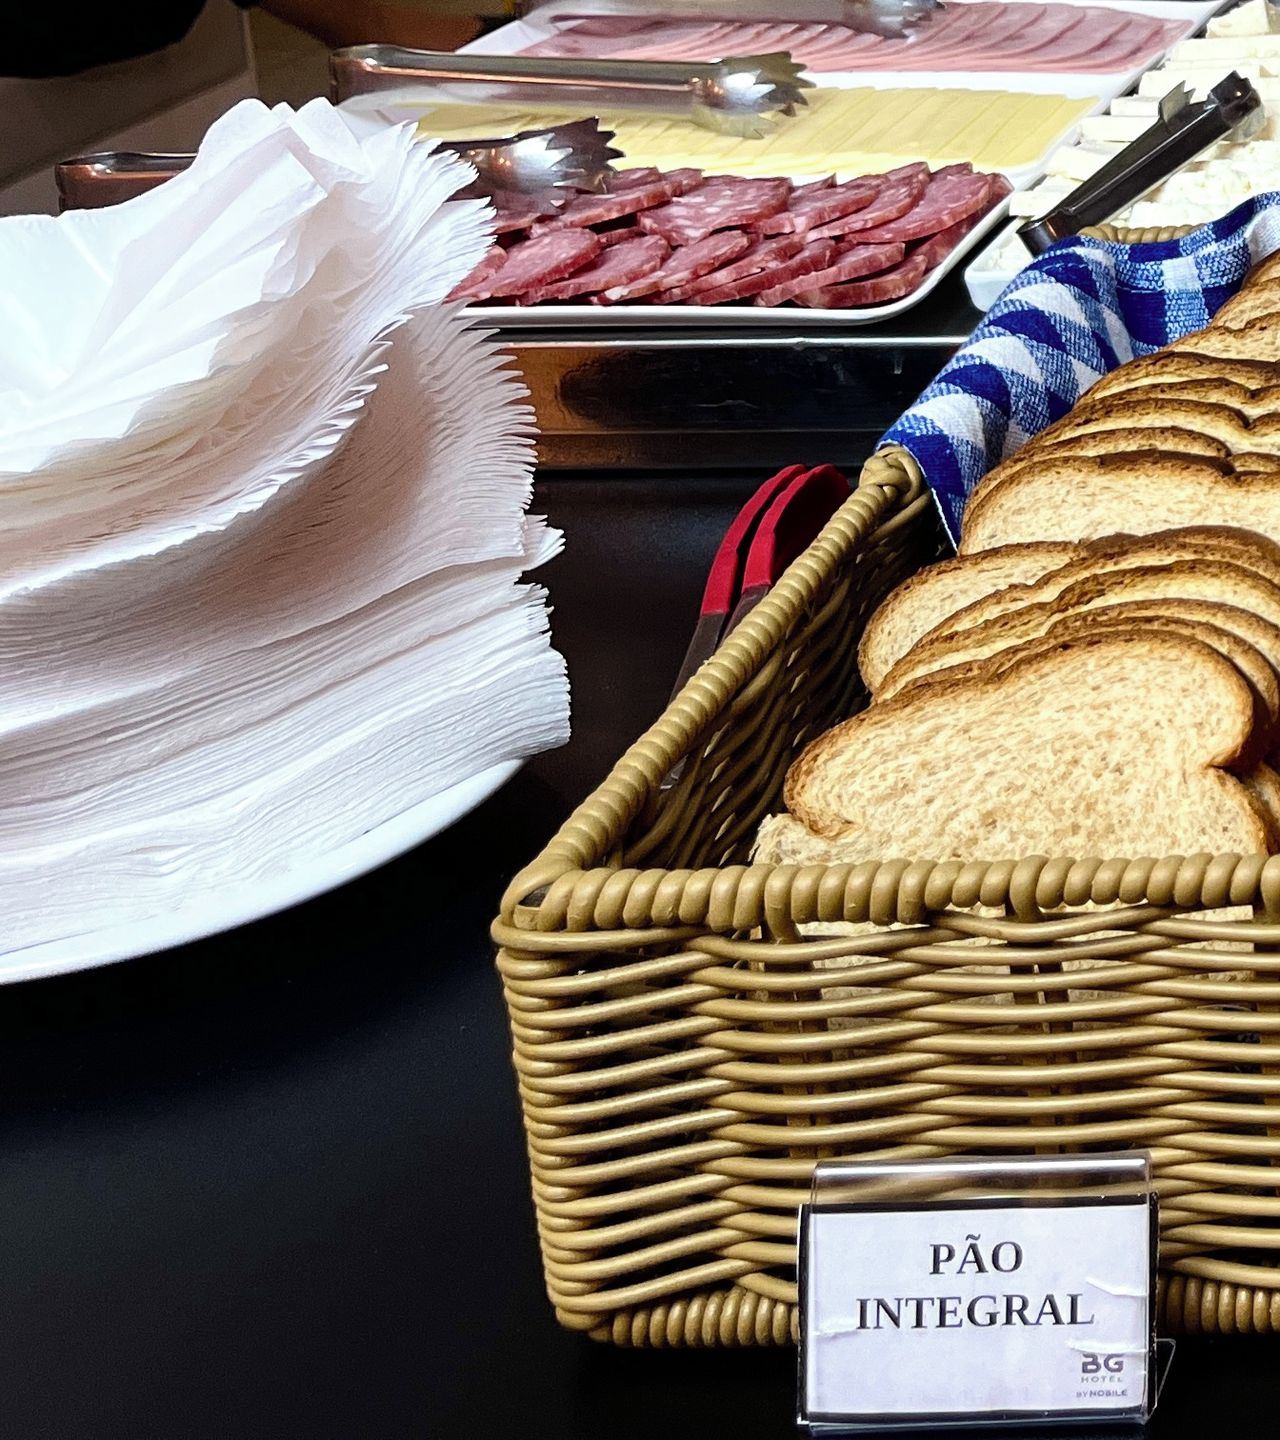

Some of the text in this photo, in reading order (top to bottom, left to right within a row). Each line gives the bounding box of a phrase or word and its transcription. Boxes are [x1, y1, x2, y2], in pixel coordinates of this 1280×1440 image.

[929, 1234, 1024, 1275] PÃO
[856, 1293, 1095, 1330] INTEGRAL
[1082, 1353, 1125, 1374] BG
[1081, 1375, 1123, 1383] HOTEL
